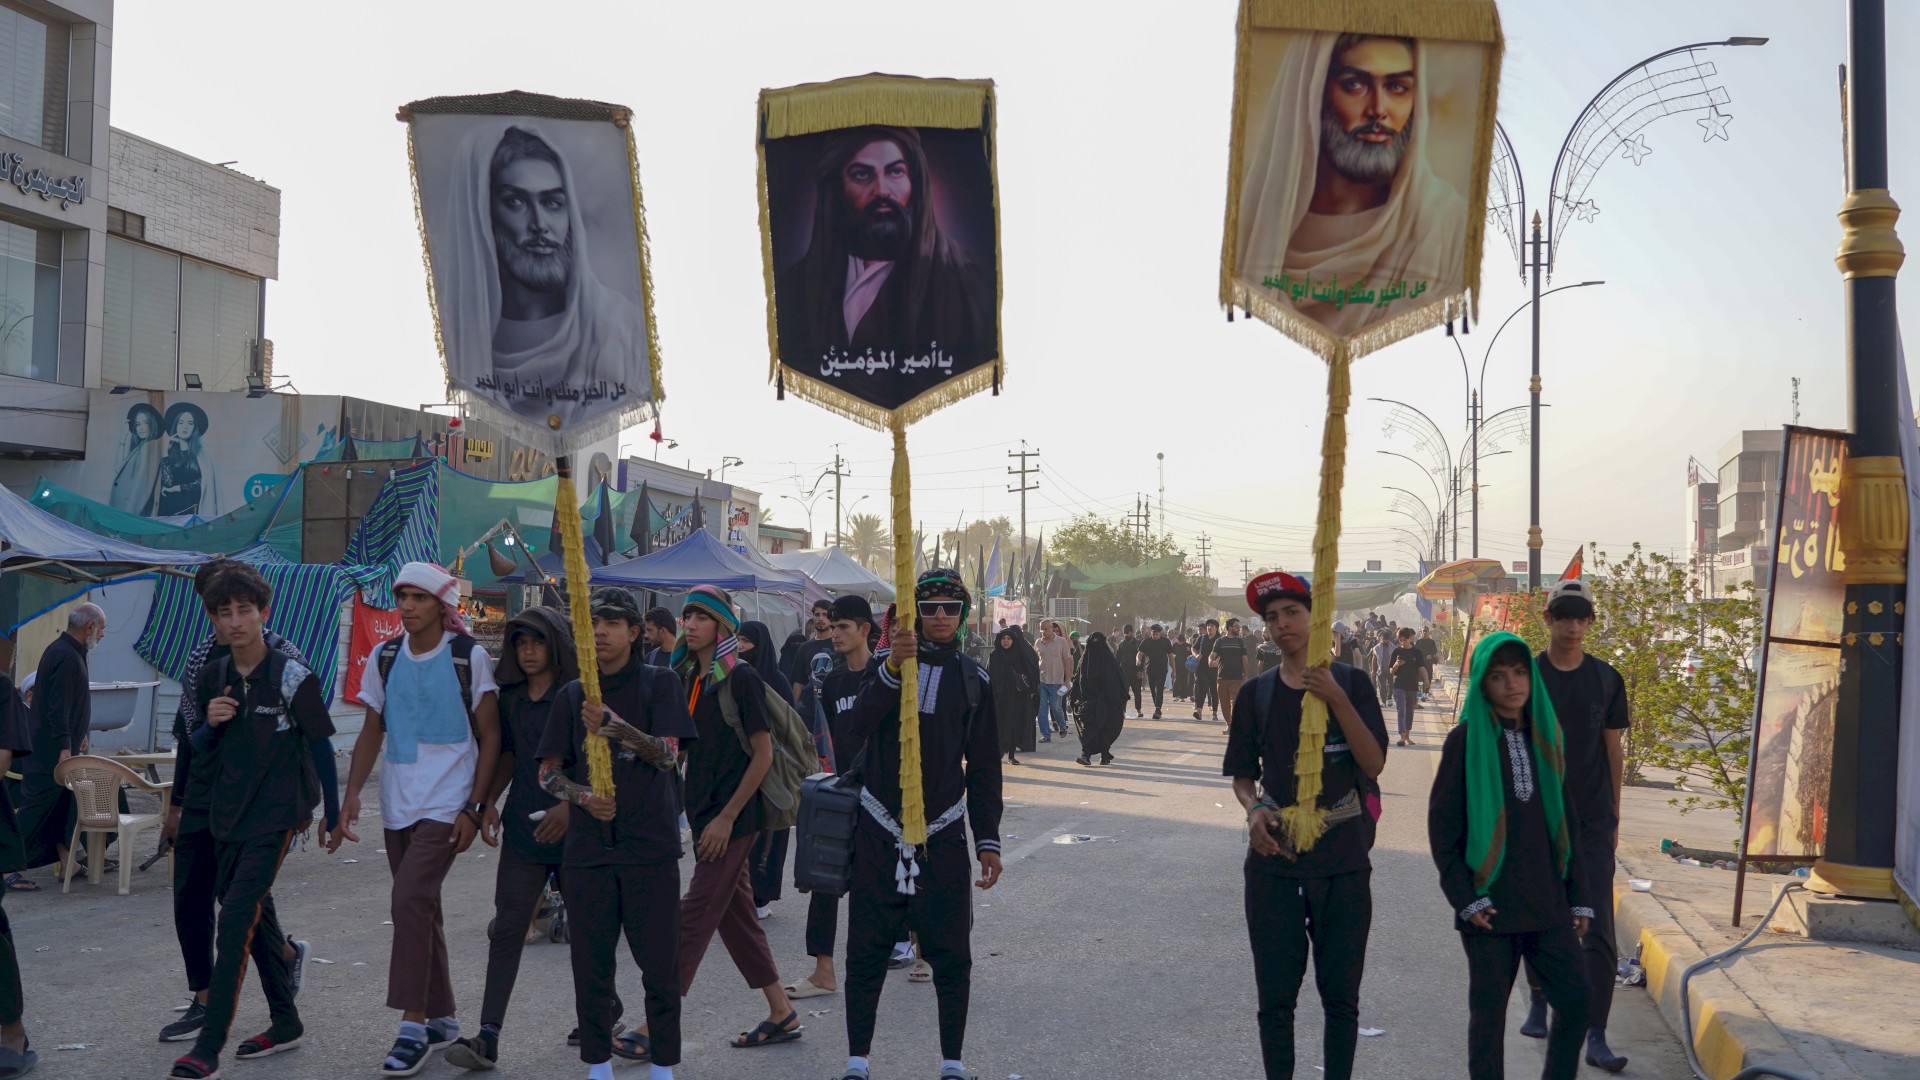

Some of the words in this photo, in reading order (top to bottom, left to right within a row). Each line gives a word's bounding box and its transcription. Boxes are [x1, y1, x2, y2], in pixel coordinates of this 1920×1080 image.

[13, 153, 86, 211] الجوهرة
[1261, 273, 1290, 291] الخير
[1291, 271, 1310, 301] أبو
[1347, 278, 1375, 304] منك
[1377, 280, 1406, 307] الخير
[1410, 280, 1427, 298] كل
[475, 373, 501, 393] الخير
[504, 370, 519, 399] أبو
[555, 380, 580, 401] منك
[581, 380, 607, 407] الخير
[610, 382, 626, 400] كل
[1254, 576, 1281, 589] LINKIN
